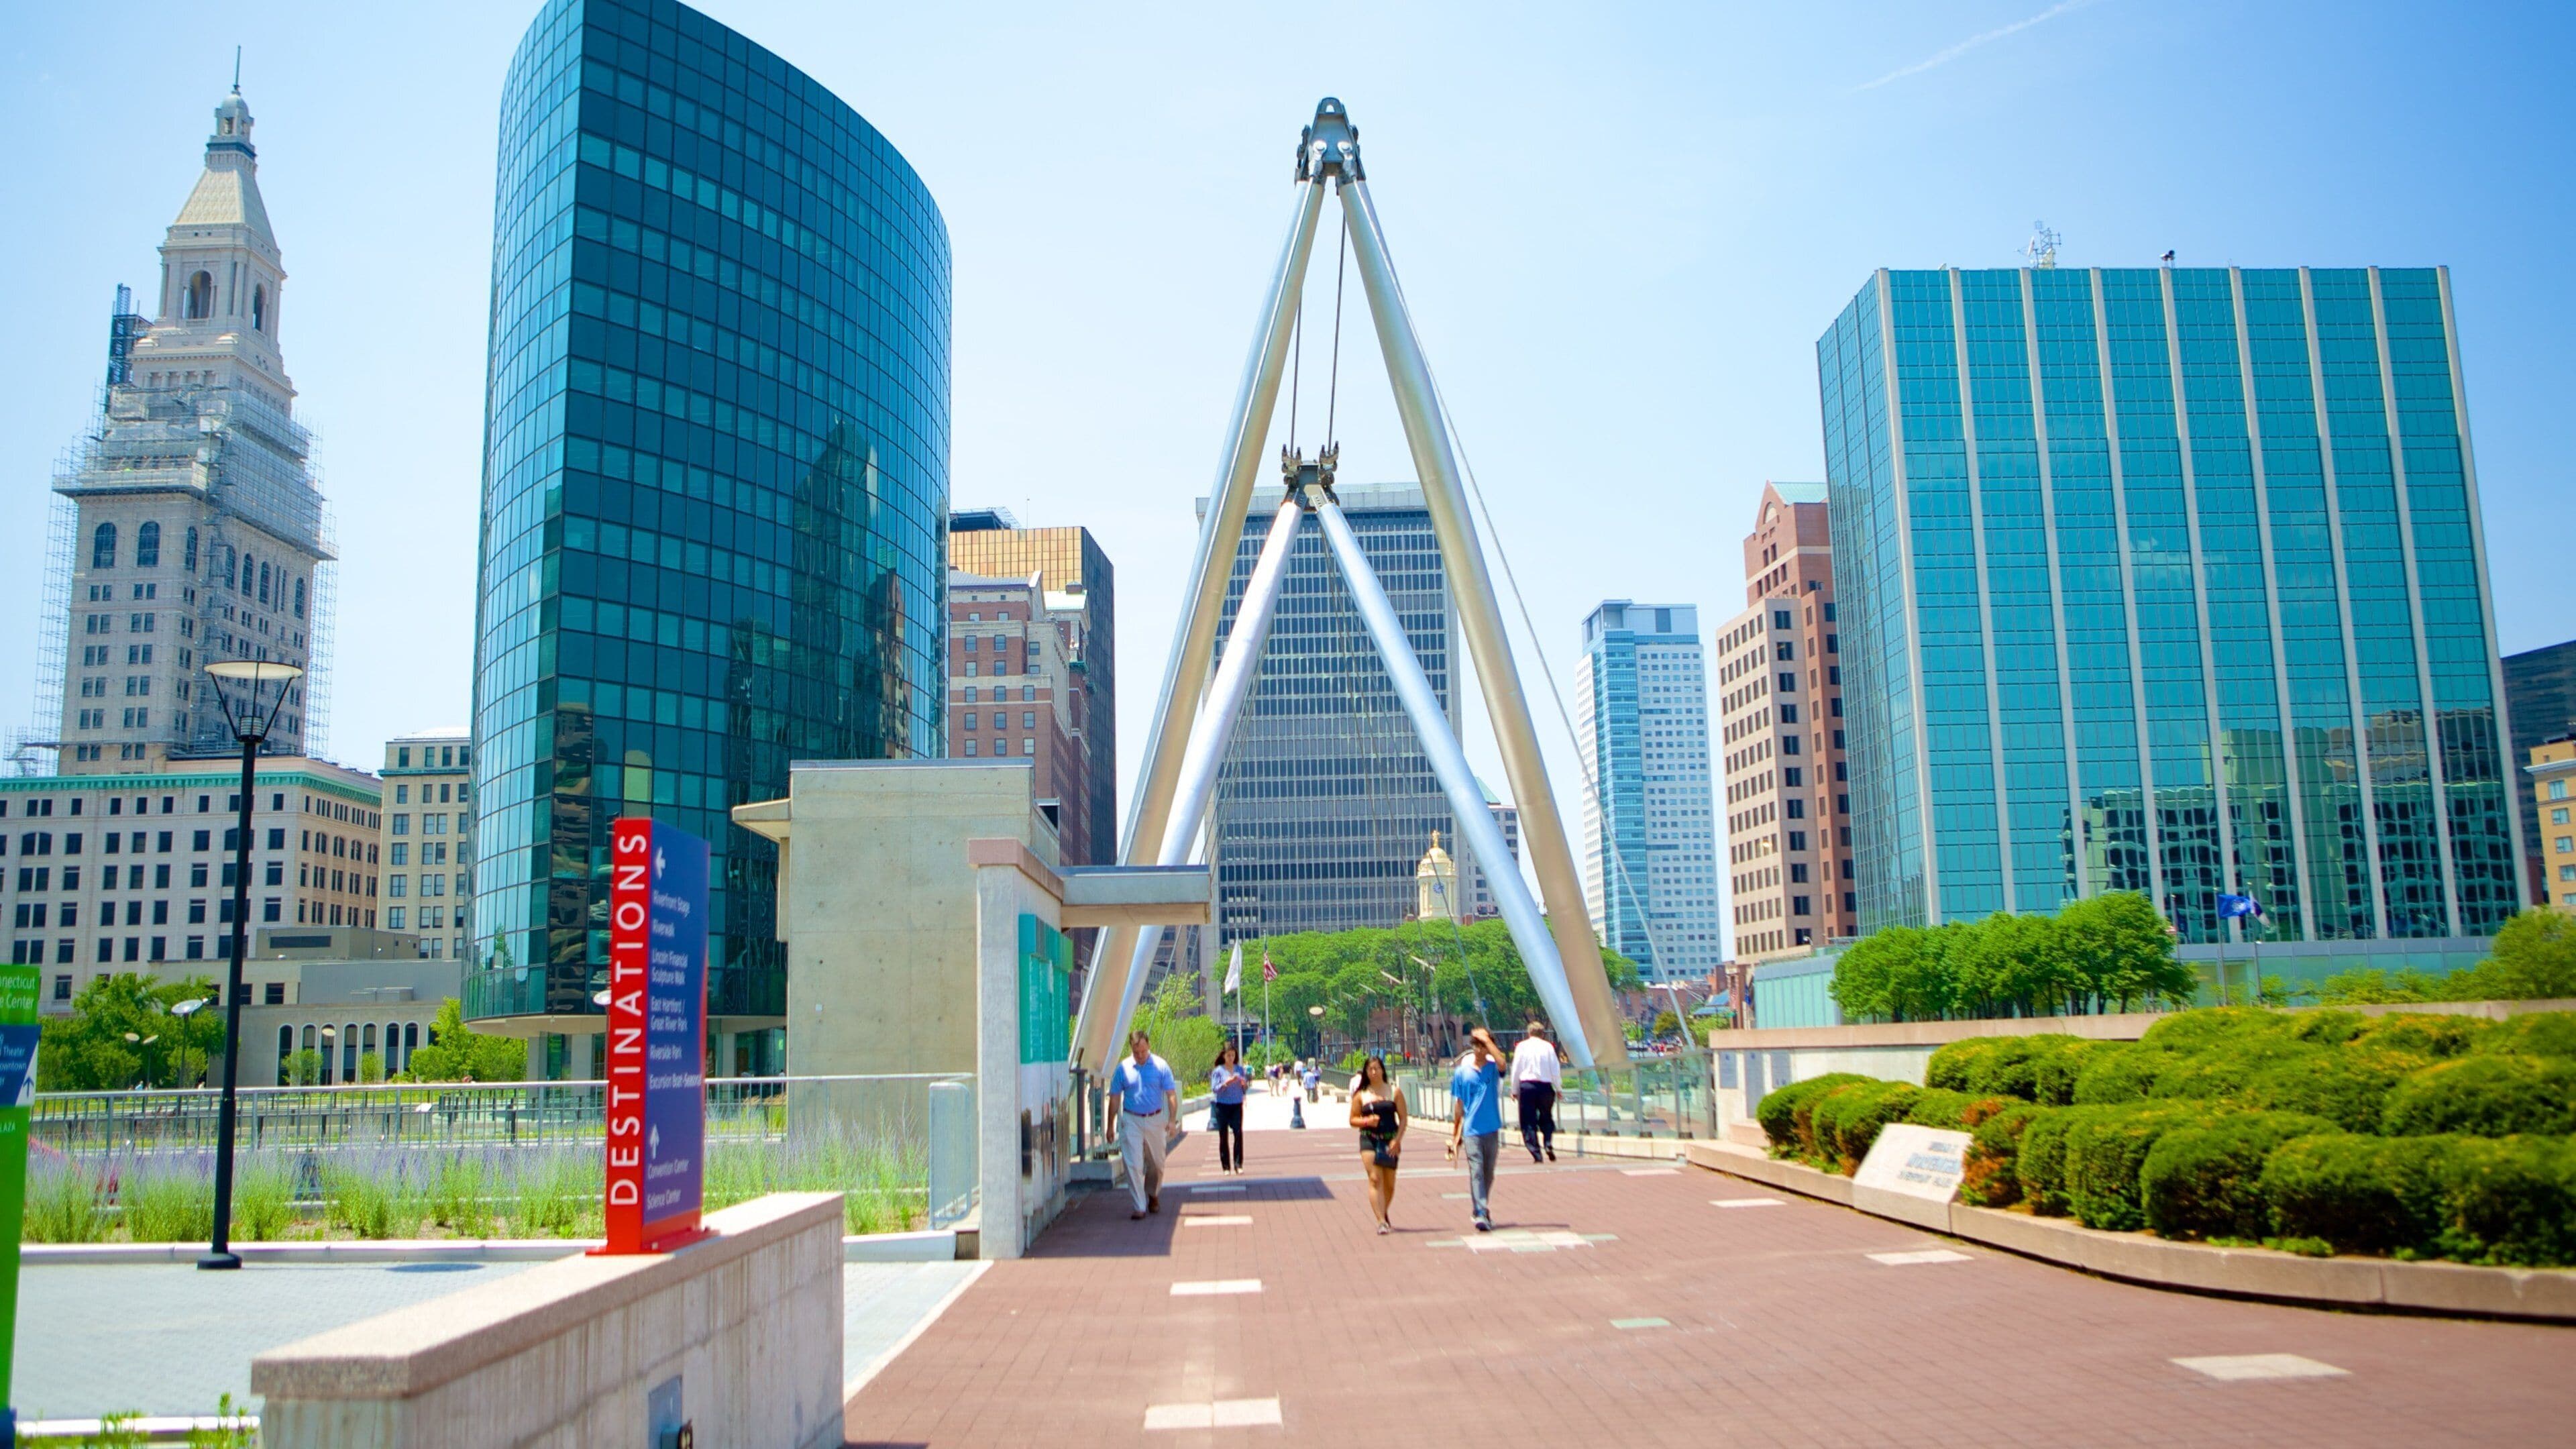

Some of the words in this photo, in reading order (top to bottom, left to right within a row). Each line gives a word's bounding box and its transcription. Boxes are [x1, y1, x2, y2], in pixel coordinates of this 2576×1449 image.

[0, 974, 36, 989] necticut
[7, 994, 34, 1010] Center
[651, 996, 661, 1012] East
[610, 835, 647, 1205] DESTINATIONS
[651, 1015, 663, 1030] Great
[665, 1016, 677, 1032] River
[678, 1017, 688, 1032] Park
[4, 1044, 25, 1058] Theater
[650, 1044, 671, 1060] Riverside
[672, 1044, 682, 1059] Park
[648, 1163, 674, 1179] Convention
[674, 1159, 689, 1174] Center
[647, 1194, 665, 1210] Science
[665, 1189, 682, 1205] Center
